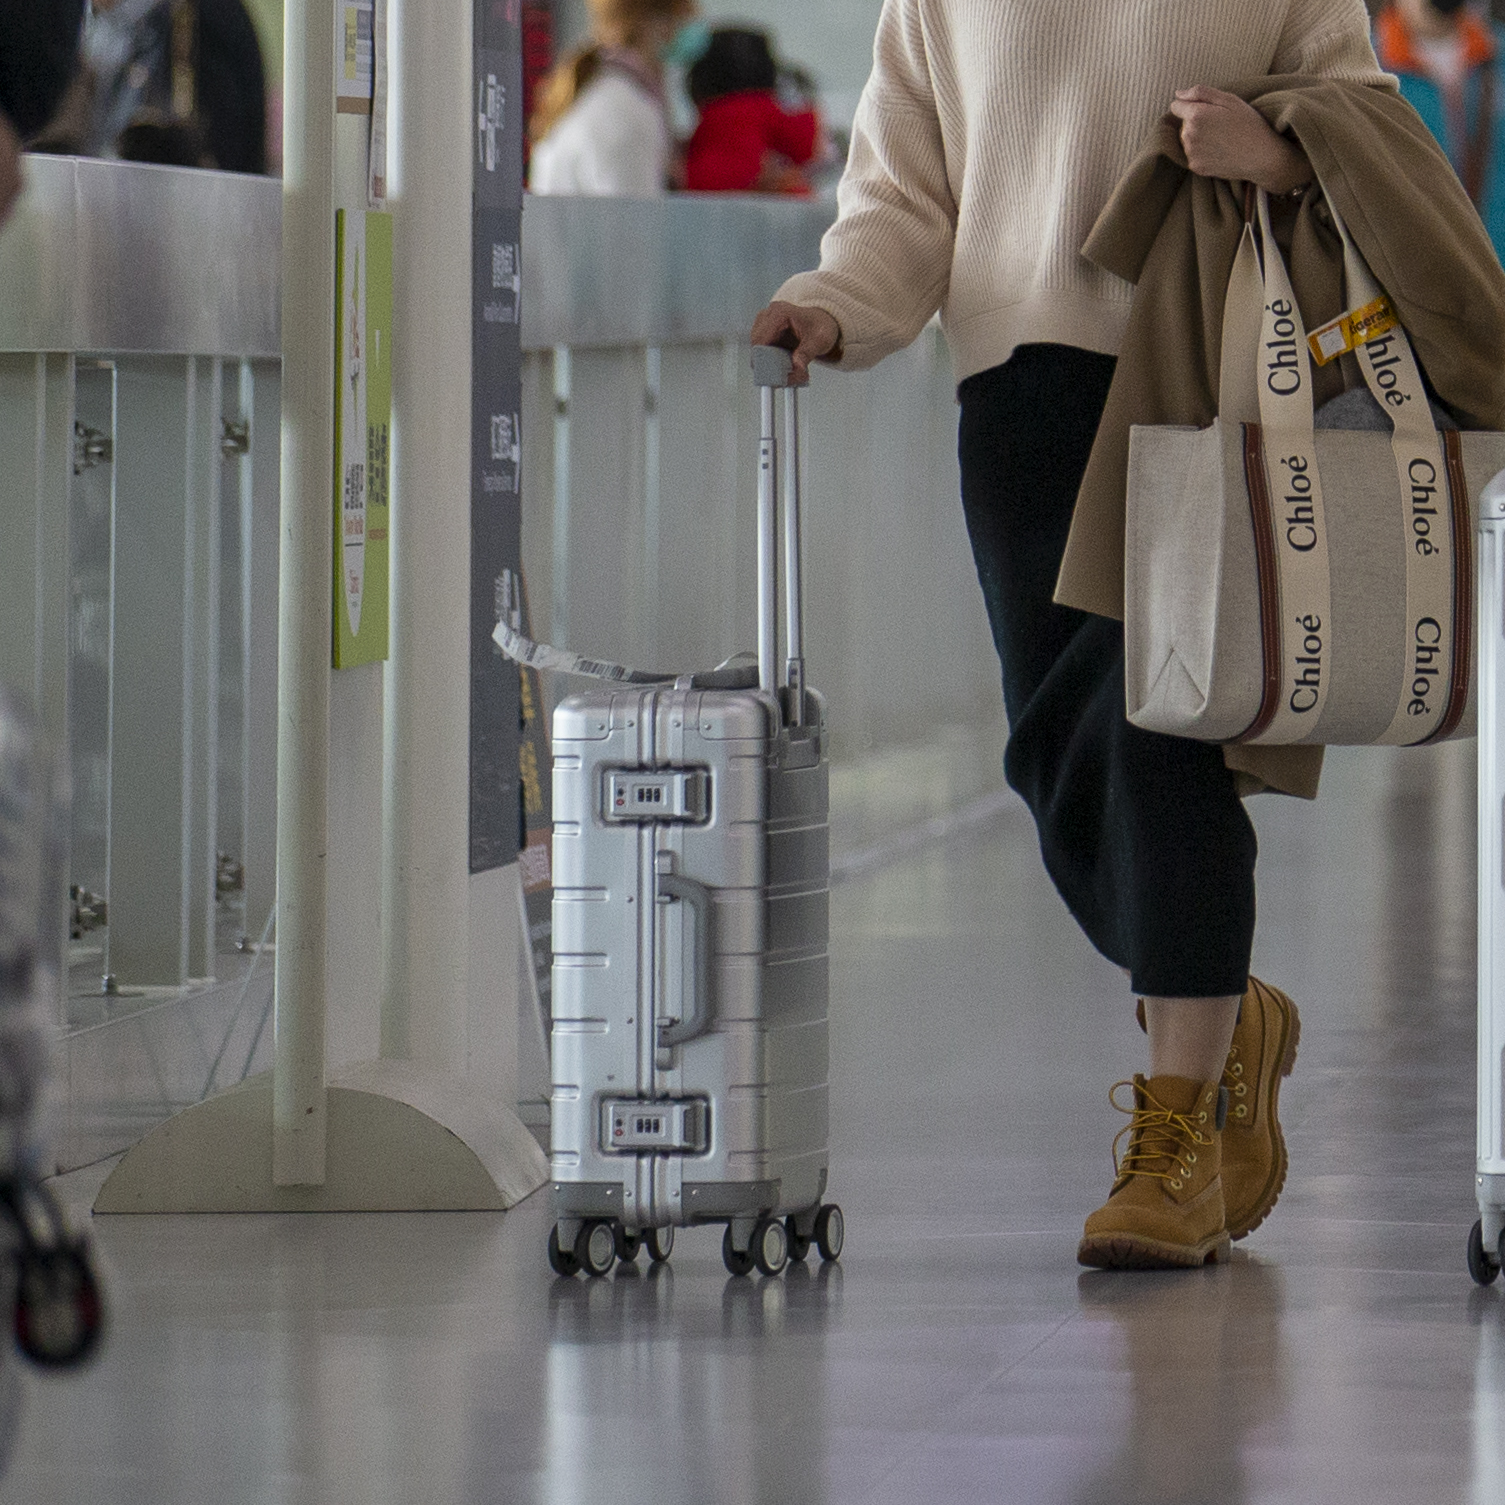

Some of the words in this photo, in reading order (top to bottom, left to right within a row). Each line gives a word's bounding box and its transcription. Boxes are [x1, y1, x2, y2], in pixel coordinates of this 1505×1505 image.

[1264, 299, 1301, 397] Chloé
[1365, 331, 1411, 410] hloé
[1281, 455, 1317, 552] Chloé
[1407, 459, 1439, 557] Chloé
[1290, 613, 1322, 714] Chloé
[1406, 616, 1441, 715] Chloé
